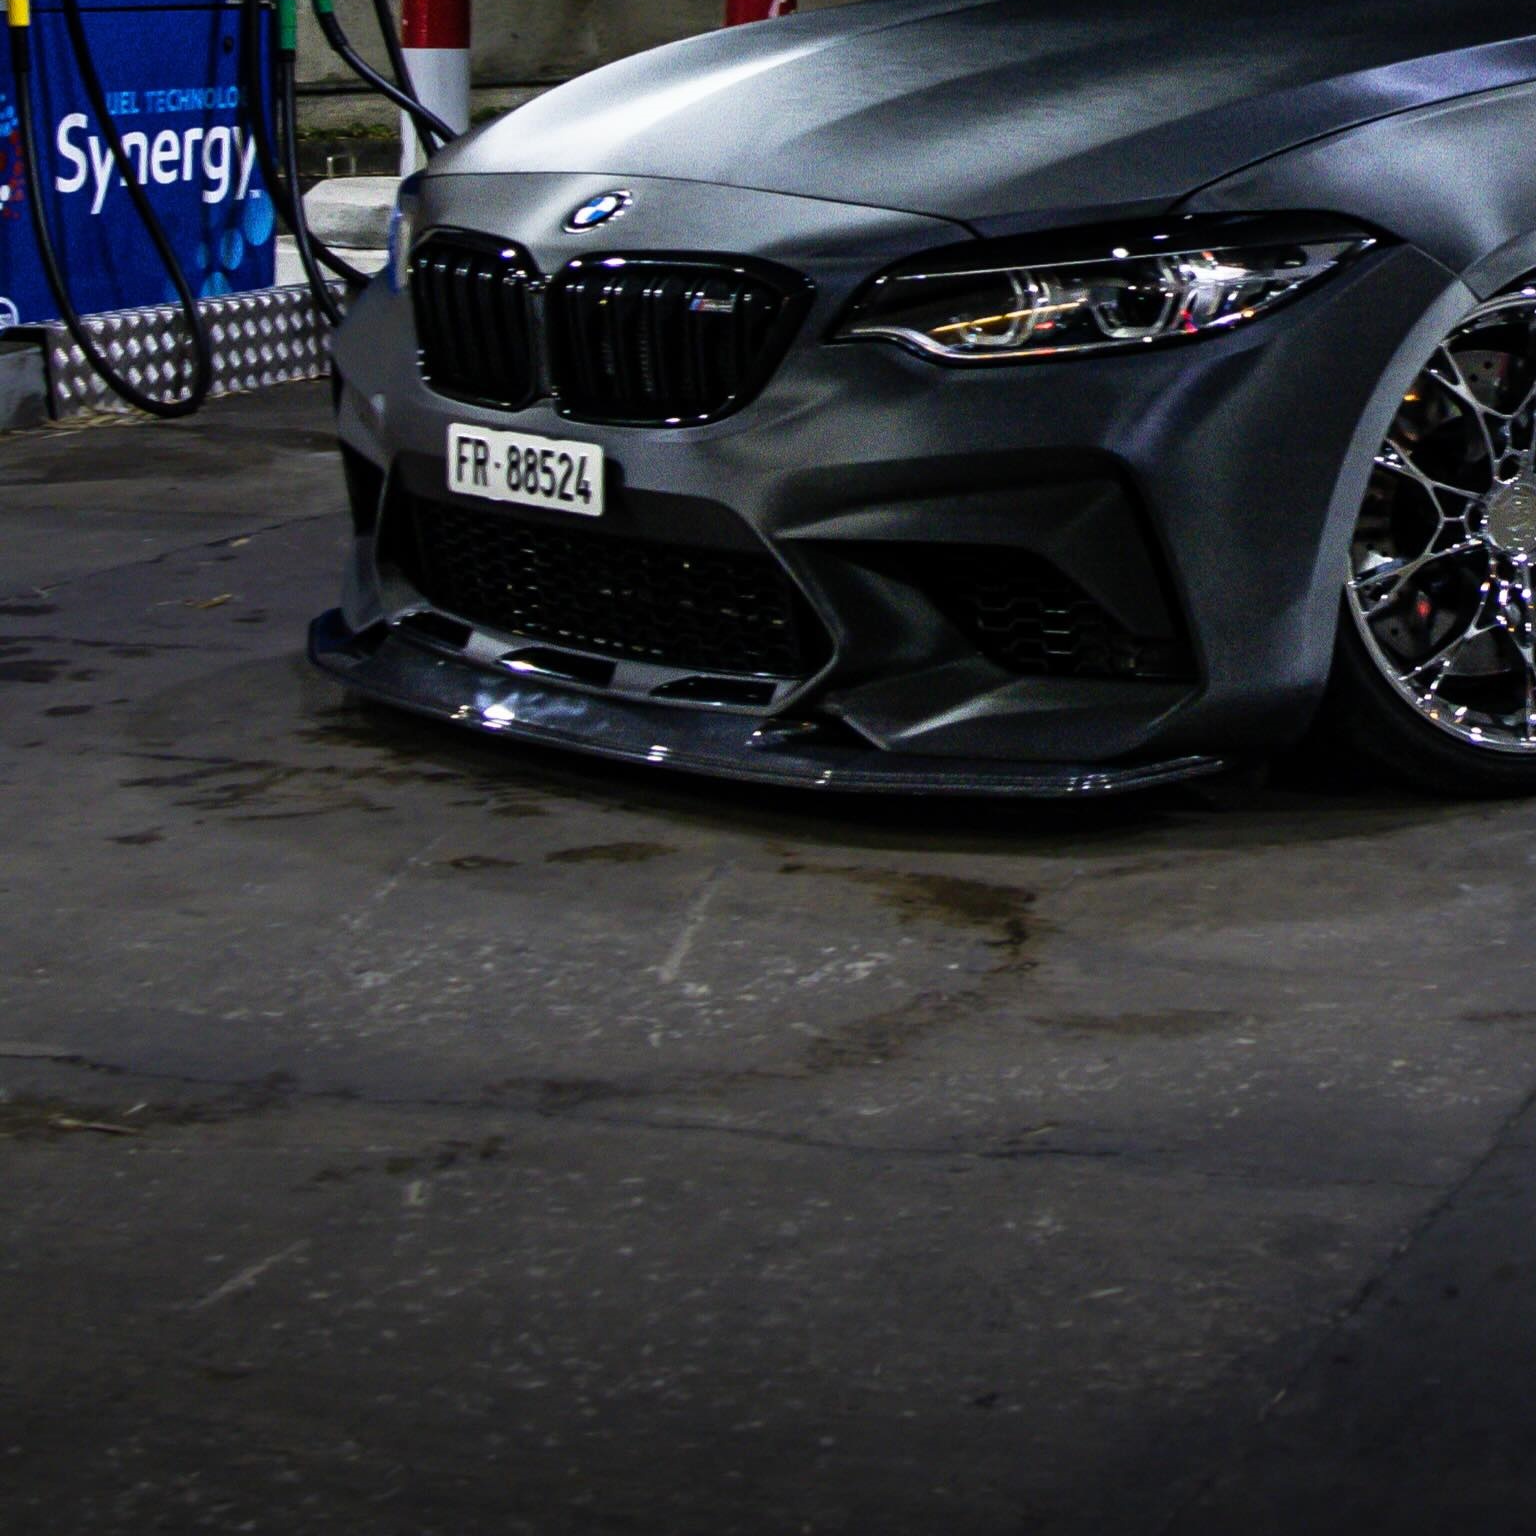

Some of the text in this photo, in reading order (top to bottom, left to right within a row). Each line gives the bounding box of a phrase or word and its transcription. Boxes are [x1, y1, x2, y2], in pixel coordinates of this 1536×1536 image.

[105, 85, 241, 115] UEL TECHNOLO
[55, 112, 258, 215] Synergy
[506, 444, 593, 505] 88524
